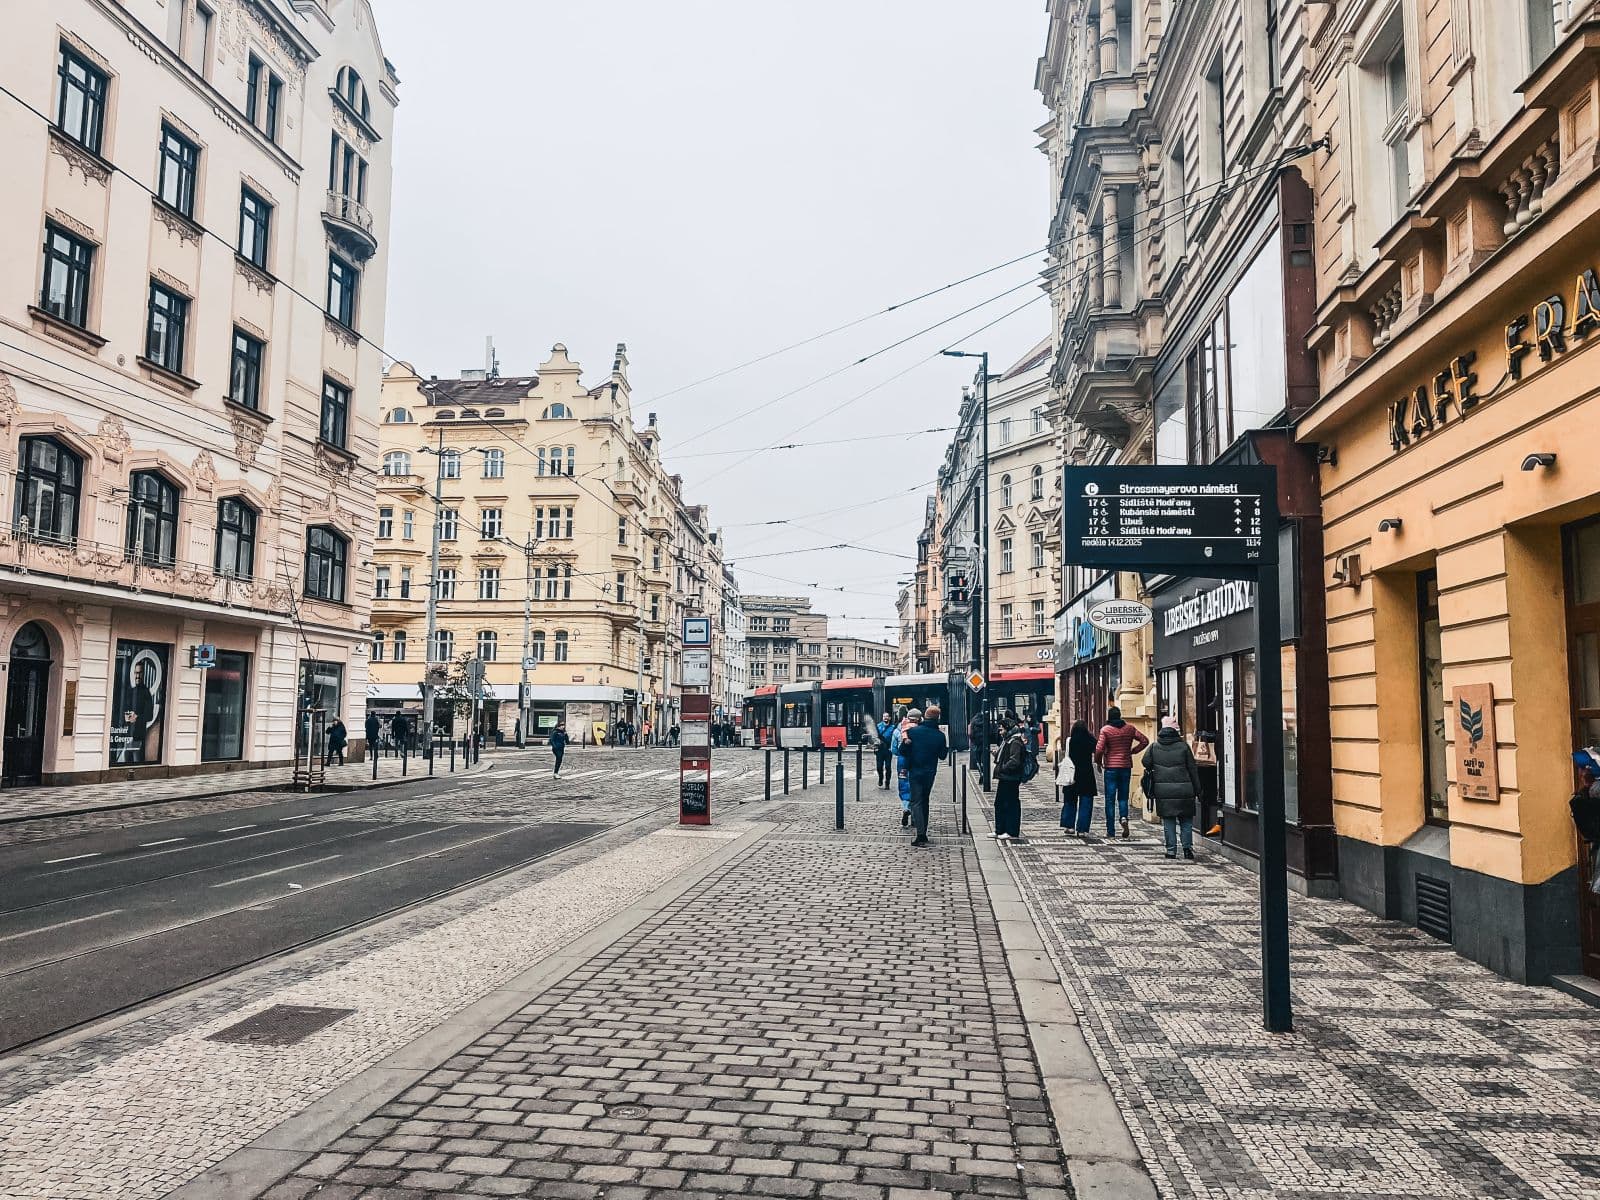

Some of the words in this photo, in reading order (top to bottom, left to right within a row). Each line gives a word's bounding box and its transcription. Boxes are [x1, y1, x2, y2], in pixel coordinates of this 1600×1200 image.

[1388, 350, 1479, 451] KAFE
[1119, 484, 1197, 495] Strossmayerovo
[1199, 483, 1239, 494] náměstí
[1088, 499, 1098, 507] 17
[1119, 498, 1155, 507] Sídliště
[1156, 497, 1191, 507] Modřany
[1254, 498, 1260, 507] 4
[1119, 508, 1159, 516] Kubánské
[1160, 507, 1196, 516] náměstí
[1254, 508, 1260, 516] 8
[1119, 517, 1144, 526] Libuš
[1250, 517, 1261, 525] 12
[1088, 527, 1098, 535] 17
[1119, 527, 1155, 535] Sídliště
[1156, 526, 1192, 536] Modřany
[1250, 527, 1261, 535] 16
[1081, 538, 1107, 546] neděle
[1247, 550, 1259, 559] pid
